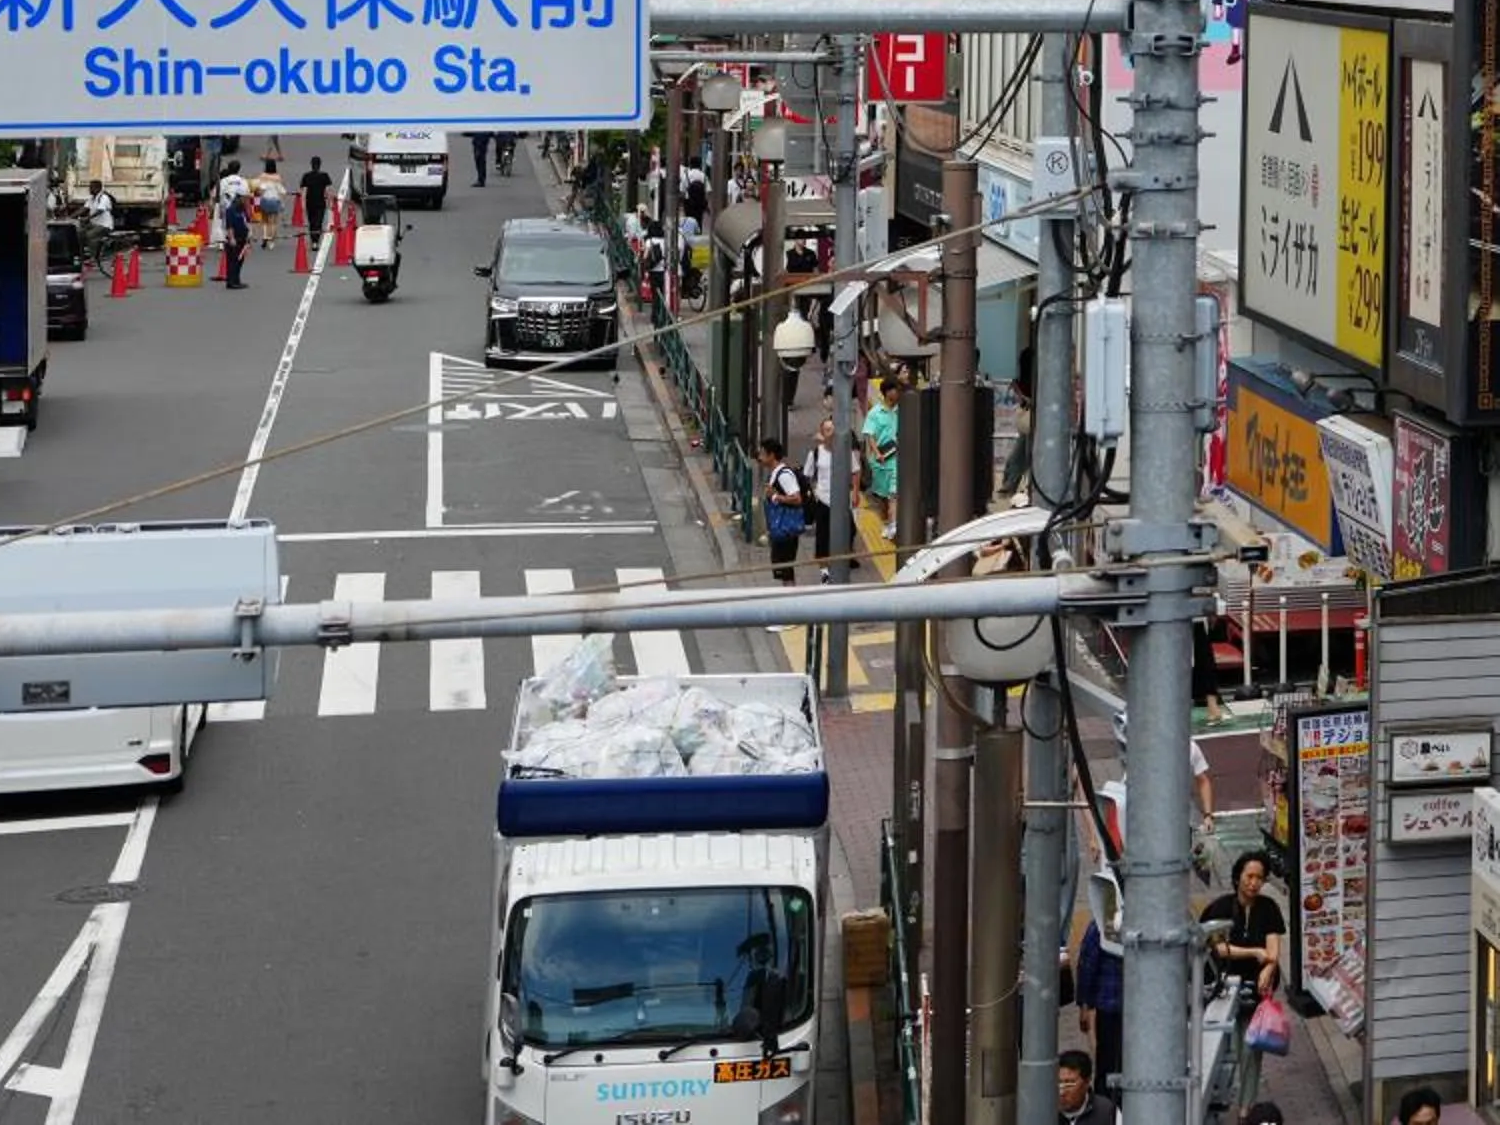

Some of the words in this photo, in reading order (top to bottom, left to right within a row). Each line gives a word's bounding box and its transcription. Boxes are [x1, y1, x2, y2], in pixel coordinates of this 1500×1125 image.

[83, 46, 408, 97] Shin-okubo
[432, 45, 531, 96] Sta.
[1357, 120, 1385, 187] 199
[1354, 264, 1382, 339] 299
[715, 1059, 790, 1081] 高圧ガス
[596, 1078, 712, 1102] SUNTORY
[616, 1109, 691, 1125] ISUZU
